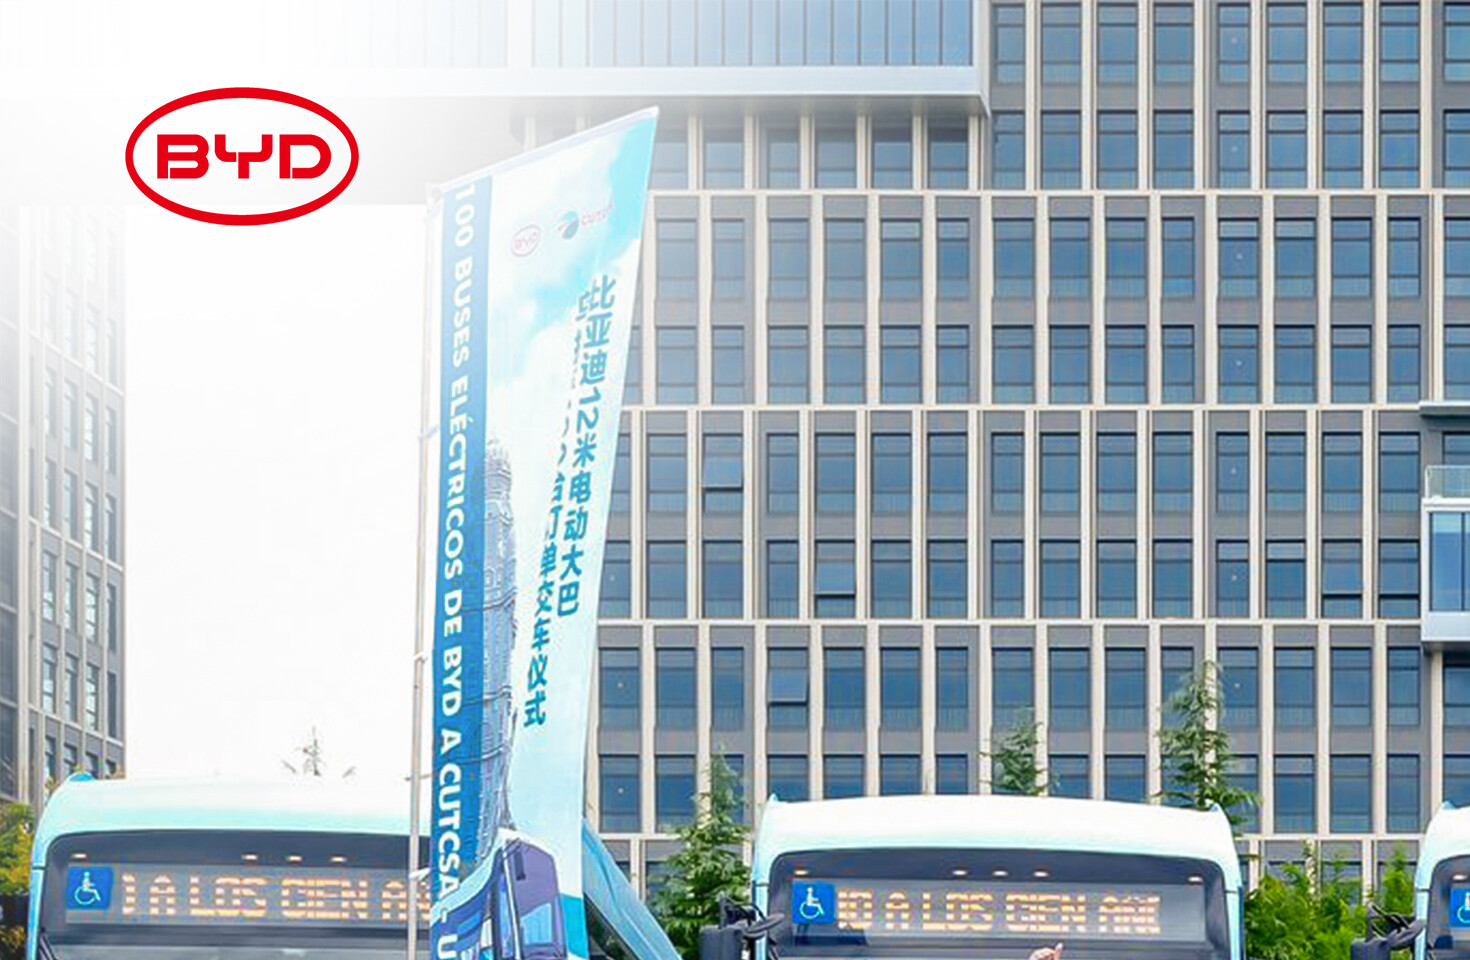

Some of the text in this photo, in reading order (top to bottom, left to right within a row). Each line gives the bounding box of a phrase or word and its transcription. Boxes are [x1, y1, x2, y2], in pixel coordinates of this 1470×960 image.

[454, 184, 476, 247] 100
[452, 256, 473, 367] BUSES
[444, 375, 474, 580] ELÉCTRICOS
[443, 589, 463, 637] DE
[441, 646, 463, 716] BYD
[440, 728, 462, 755] A
[438, 763, 462, 904] CUTCSA
[189, 876, 268, 917] LOS
[922, 892, 993, 932] LOS
[1005, 892, 1086, 933] CIEN
